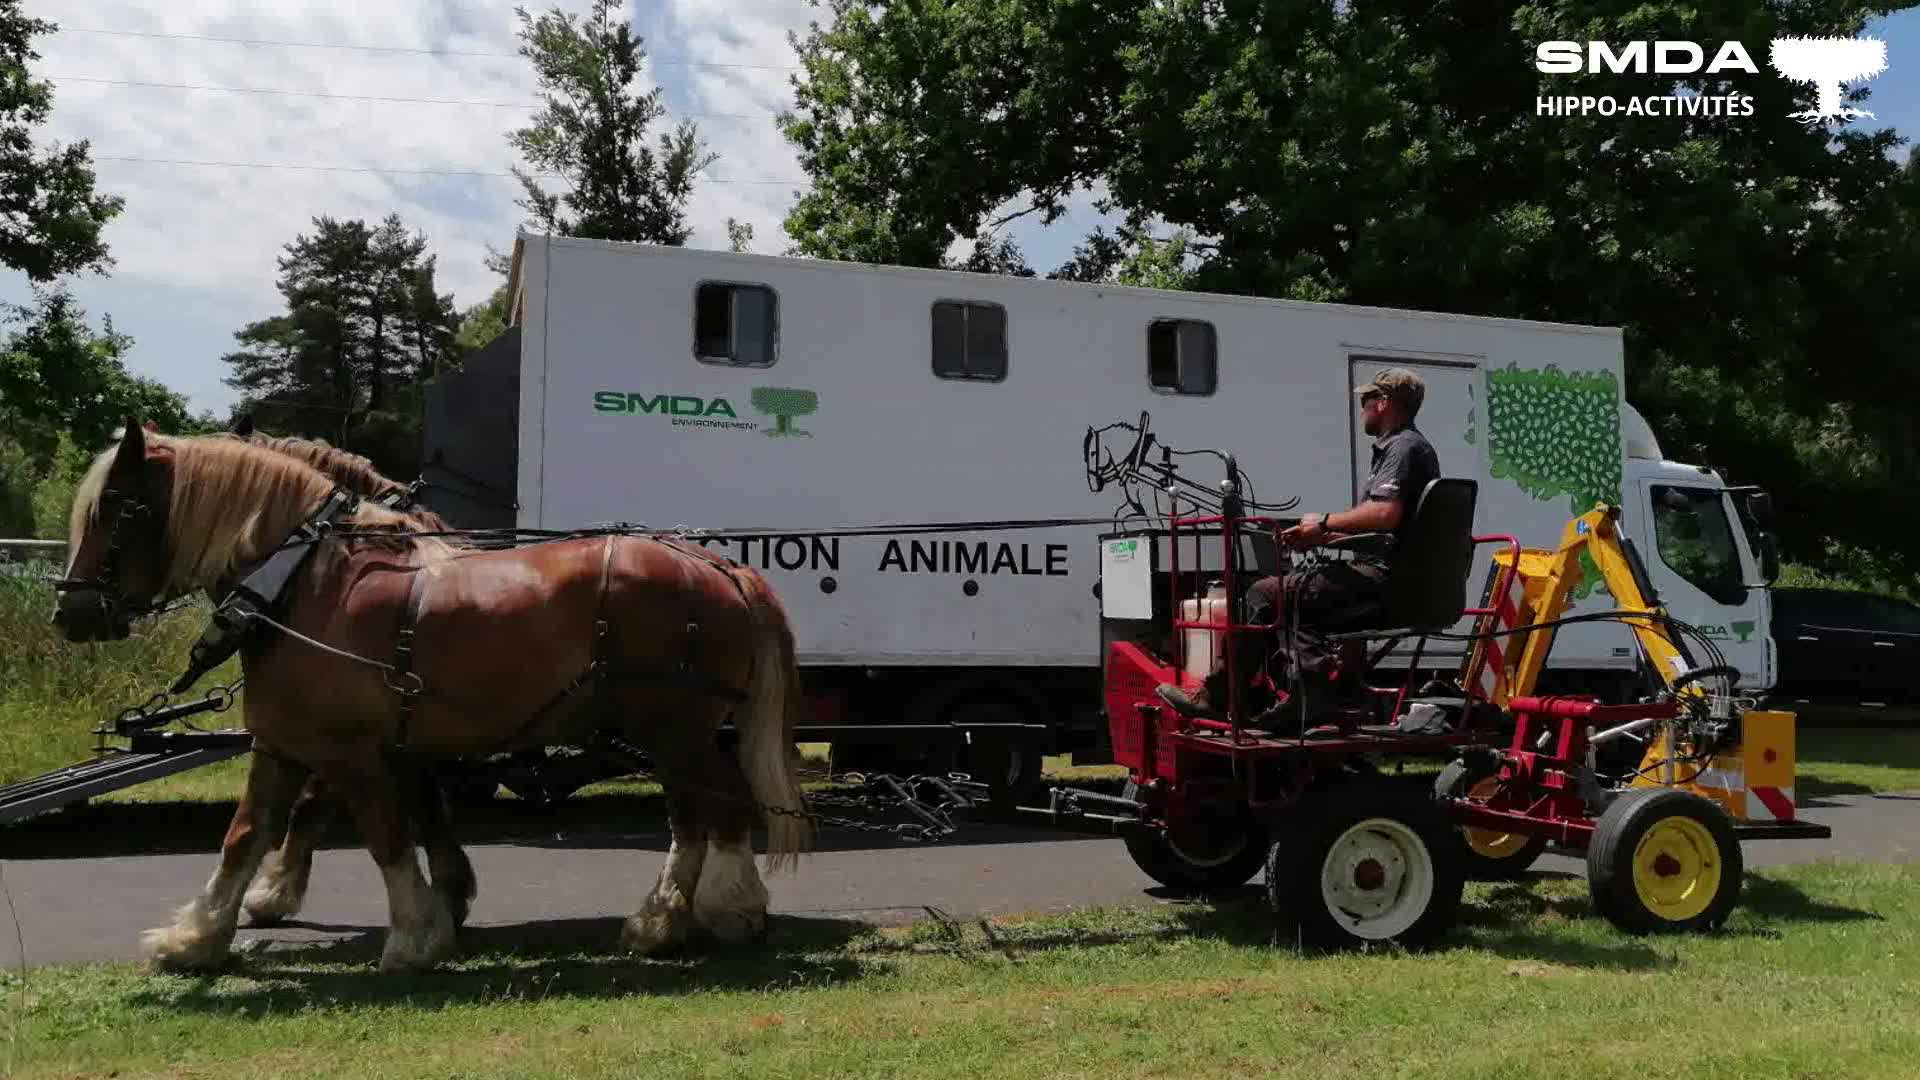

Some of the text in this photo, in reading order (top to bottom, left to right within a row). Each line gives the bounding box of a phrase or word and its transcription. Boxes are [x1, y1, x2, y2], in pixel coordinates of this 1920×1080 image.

[594, 391, 737, 418] SMDA
[671, 417, 760, 431] ENVIRONNEMENT
[699, 534, 1069, 577] CTION ANIMALE
